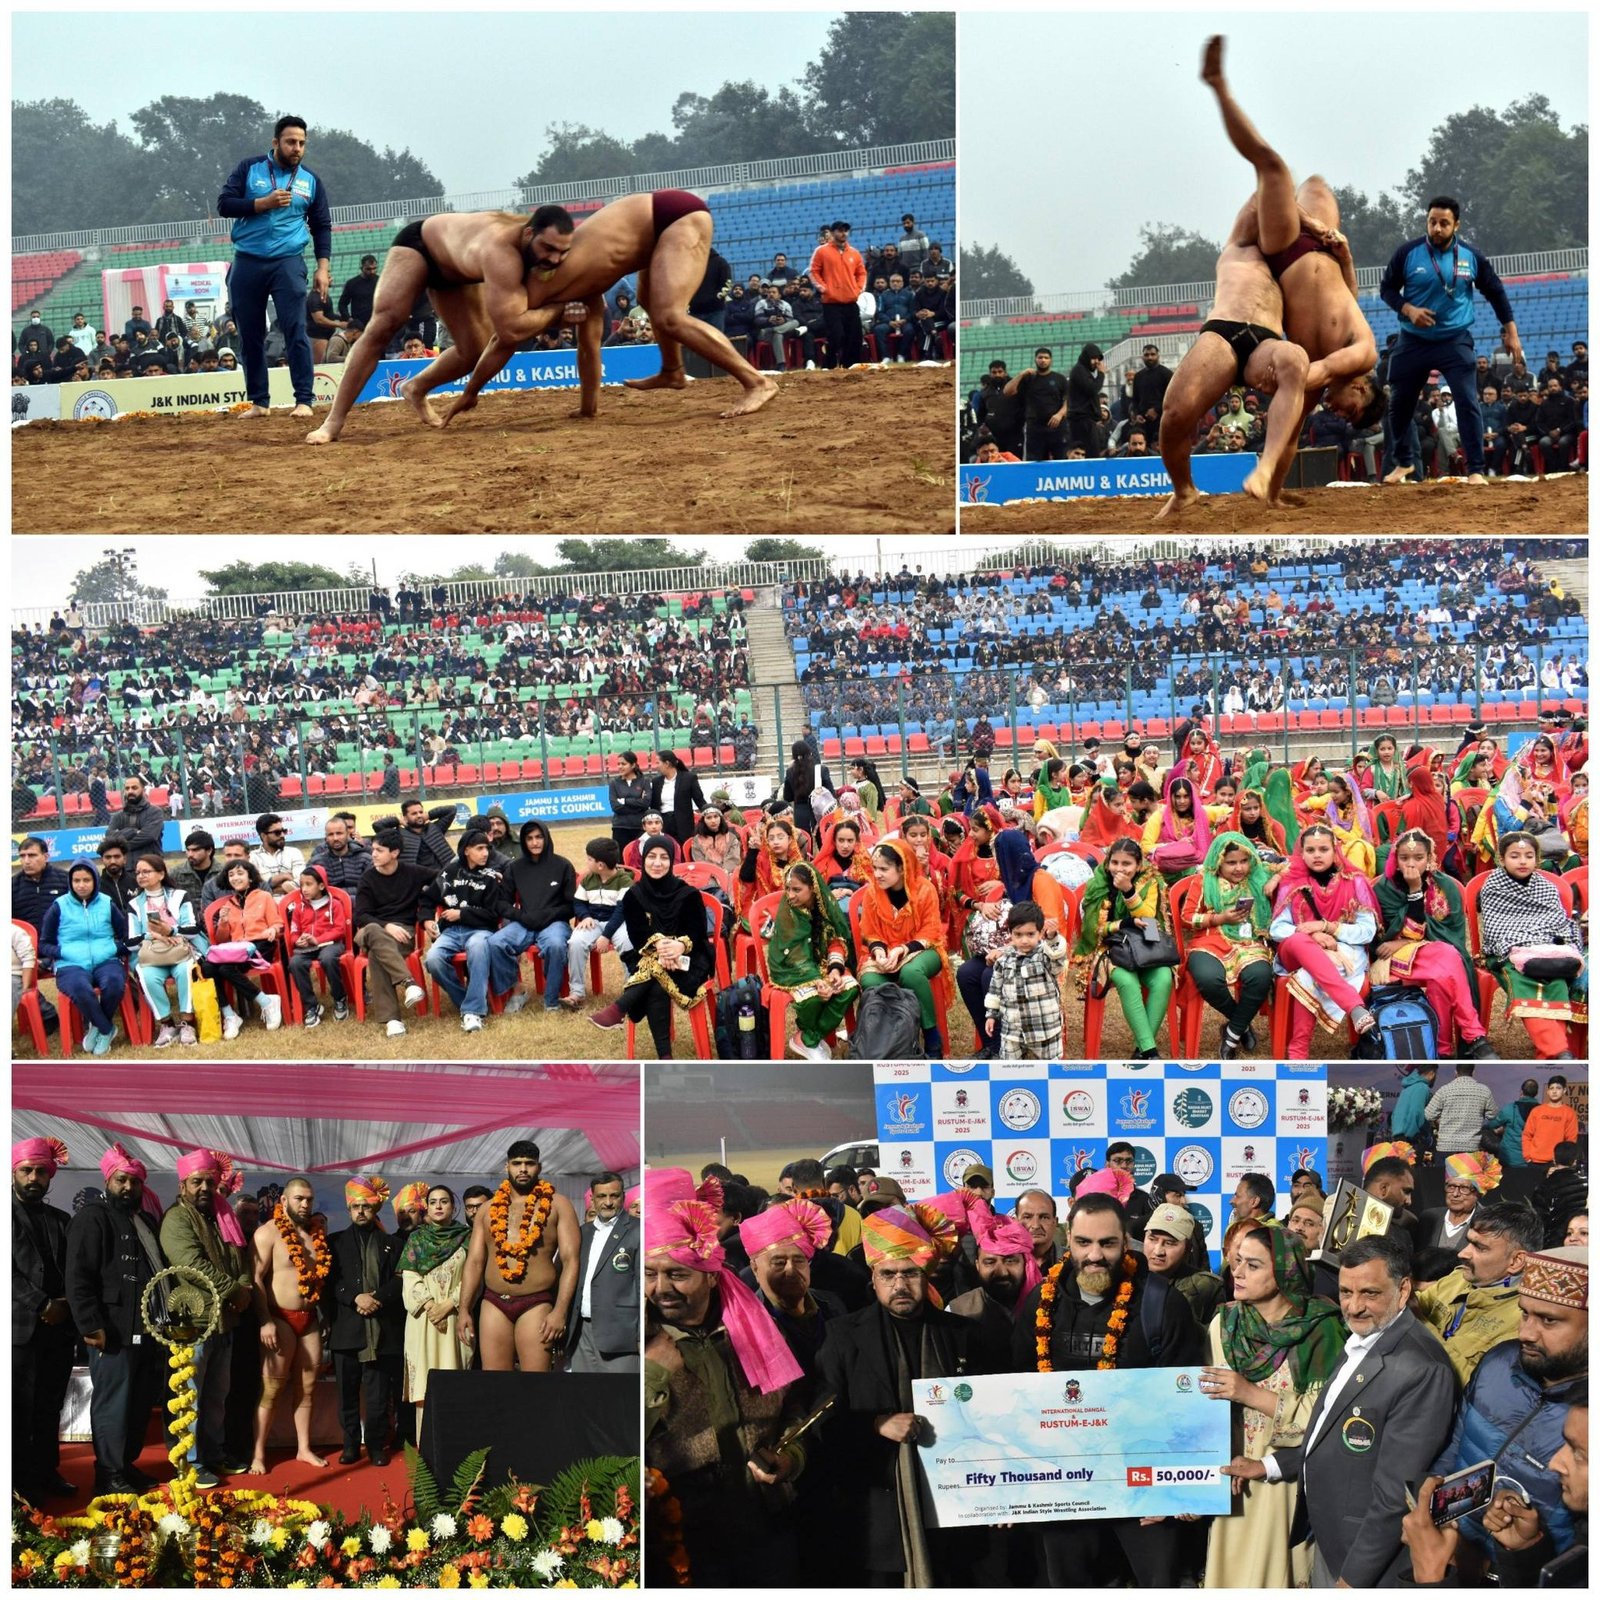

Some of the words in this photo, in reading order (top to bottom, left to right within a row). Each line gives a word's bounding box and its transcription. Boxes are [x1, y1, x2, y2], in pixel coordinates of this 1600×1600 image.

[516, 369, 526, 382] &
[151, 396, 172, 407] J&K
[177, 393, 220, 406] INDIAN
[224, 391, 247, 403] STY
[1036, 476, 1095, 492] JAMMU
[1101, 476, 1111, 489] &
[1116, 472, 1173, 488] KASHM
[525, 796, 552, 806] JAMMU
[561, 793, 596, 803] KASHMIR
[519, 805, 558, 817] SPORTS
[562, 802, 605, 813] COUNCIL
[1040, 1419, 1108, 1429] RUSTUM-E-J&K
[966, 1472, 996, 1486] Fifty
[1000, 1469, 1062, 1482] Thousand
[1066, 1468, 1094, 1481] only
[1131, 1471, 1150, 1482] Rs.
[1157, 1470, 1215, 1483] 50,000/-
